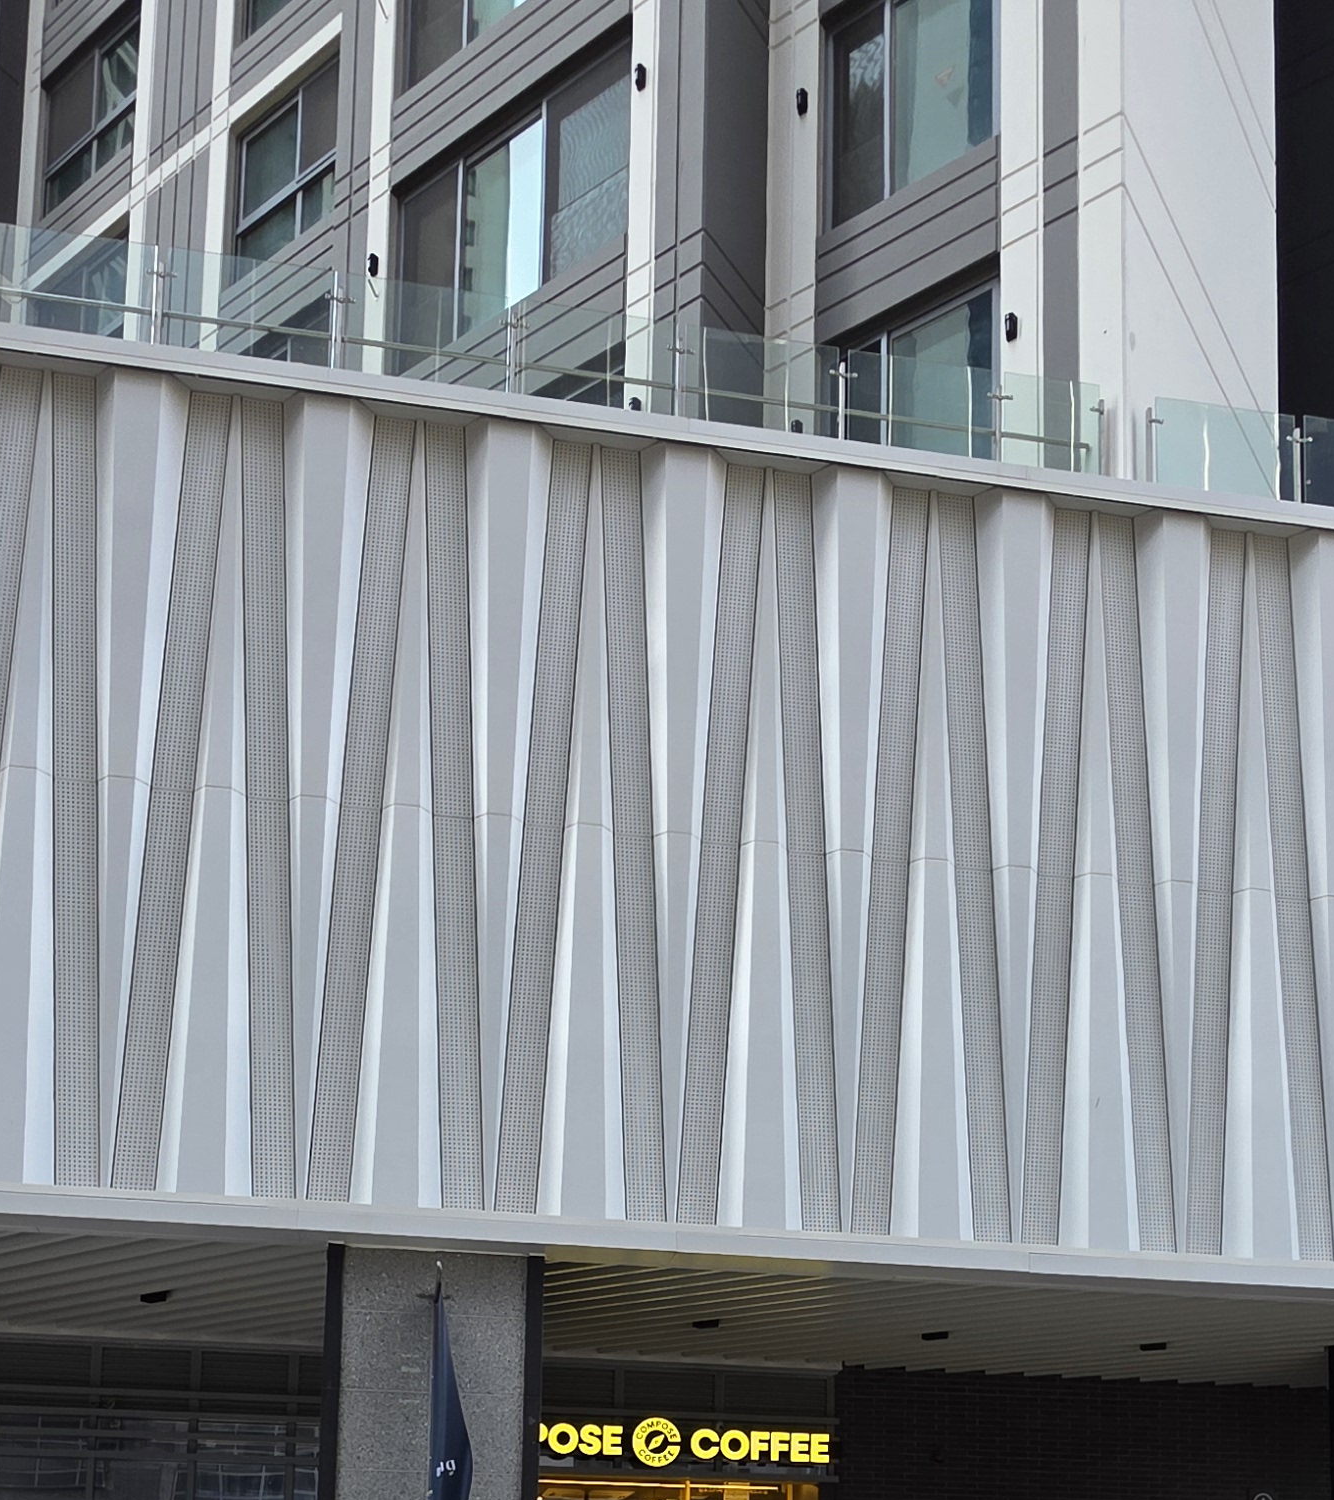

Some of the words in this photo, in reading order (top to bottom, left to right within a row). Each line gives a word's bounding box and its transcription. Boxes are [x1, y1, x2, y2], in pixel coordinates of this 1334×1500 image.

[636, 1420, 678, 1440] COMPOSE
[690, 1428, 830, 1463] COFFEE
[638, 1449, 675, 1463] COFFEE
